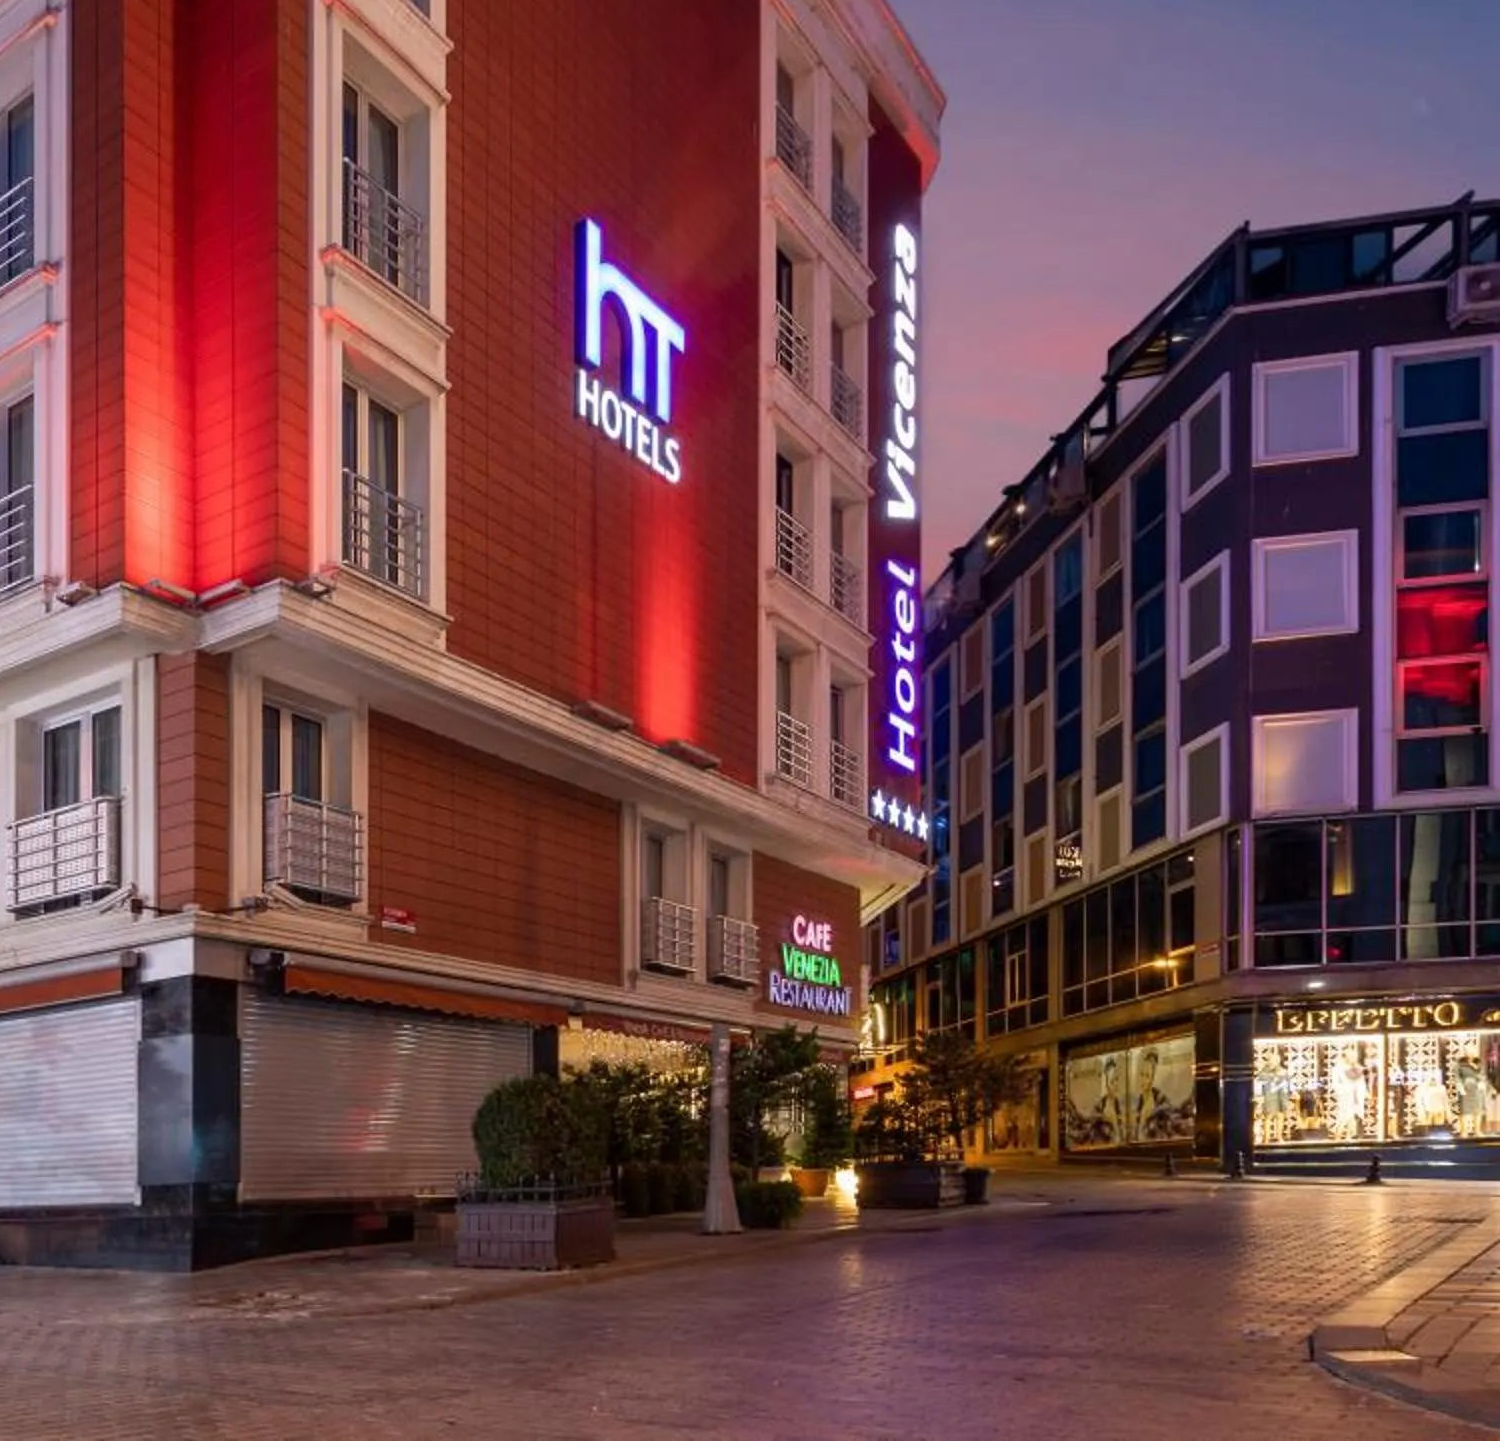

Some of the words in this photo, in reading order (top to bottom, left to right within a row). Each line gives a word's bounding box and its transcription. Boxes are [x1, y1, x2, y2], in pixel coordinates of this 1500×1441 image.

[886, 223, 918, 521] Vicenza
[576, 367, 682, 485] HOTELS
[888, 559, 917, 773] Hotel
[782, 943, 841, 987] VENEZIA
[793, 914, 832, 952] CAFE
[769, 970, 852, 1016] RESTAURANT
